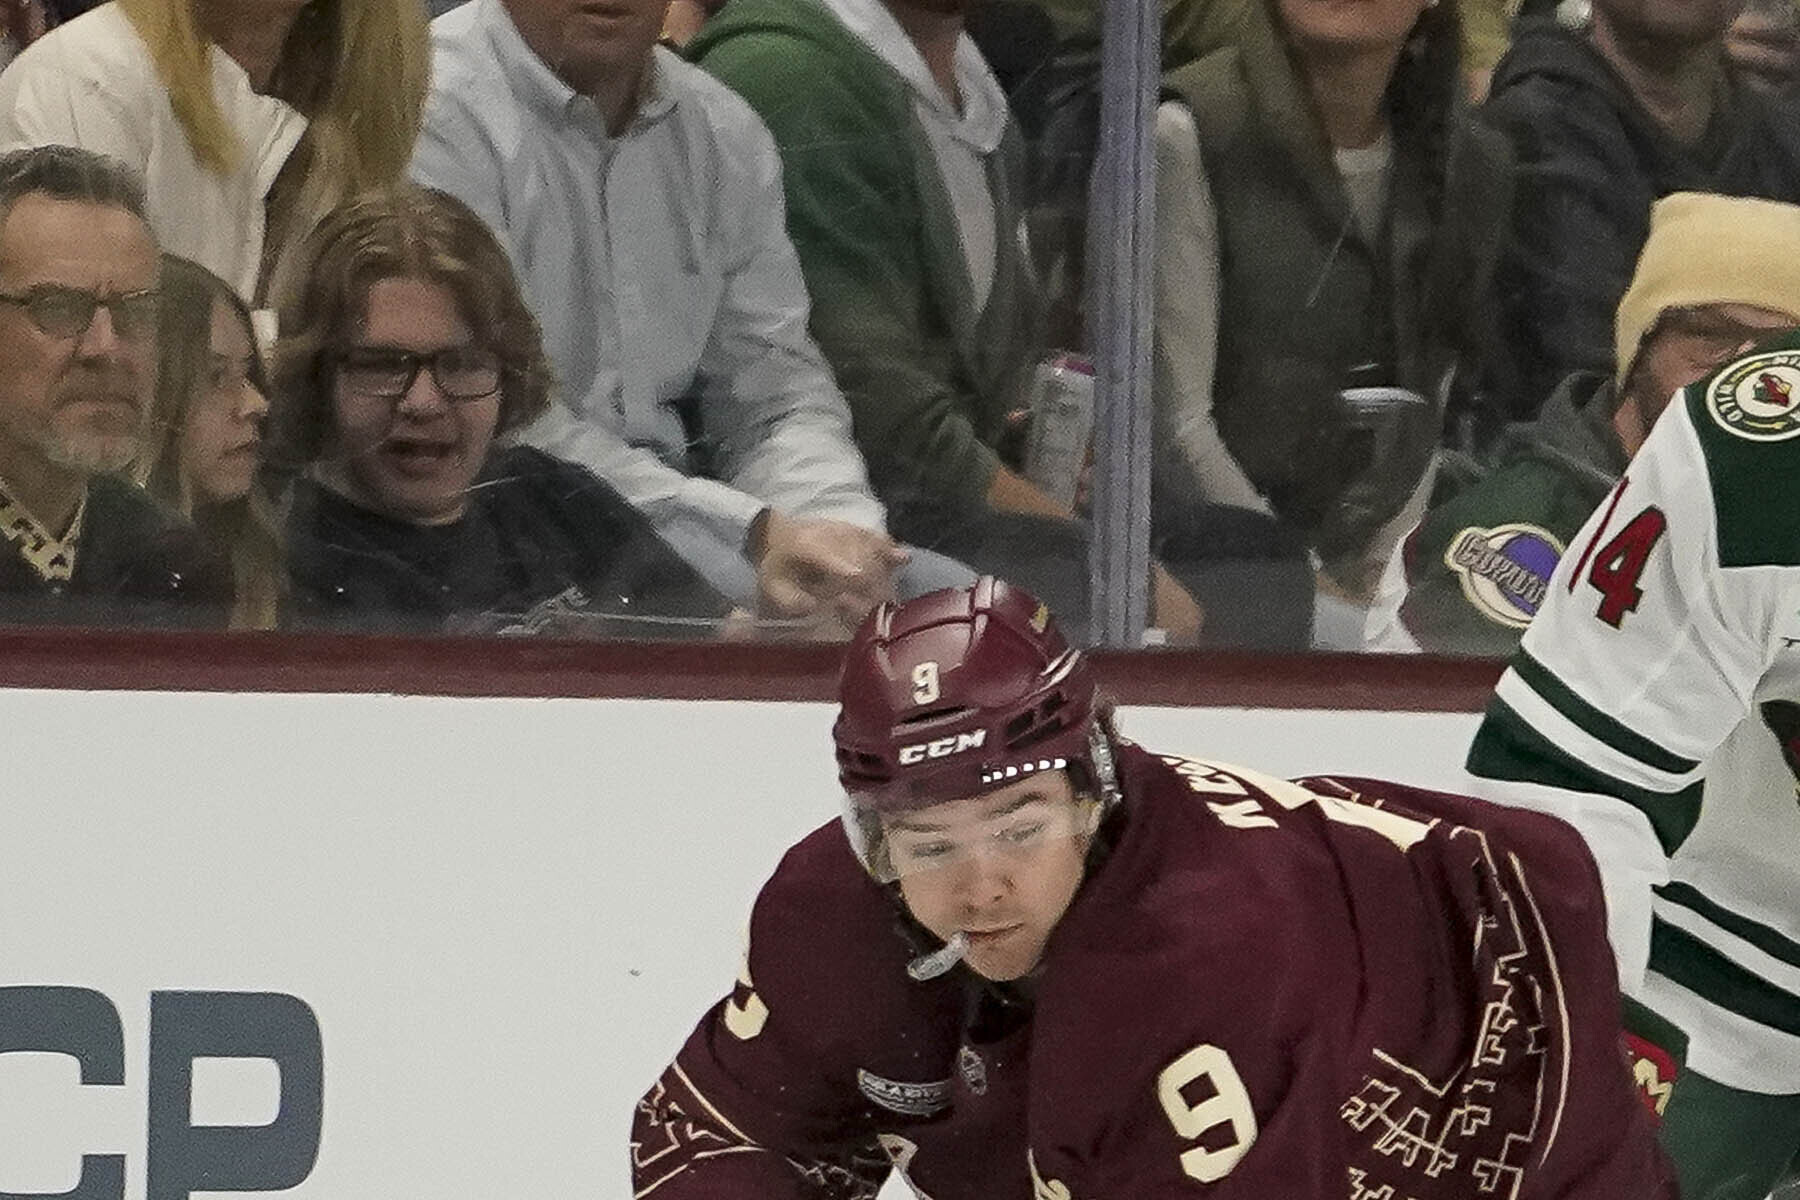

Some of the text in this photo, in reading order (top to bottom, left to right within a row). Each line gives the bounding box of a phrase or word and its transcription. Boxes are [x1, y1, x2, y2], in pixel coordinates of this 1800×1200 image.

[1568, 475, 1667, 631] 14
[911, 660, 942, 706] 9
[898, 728, 988, 766] CCM
[1157, 1044, 1259, 1184] 9
